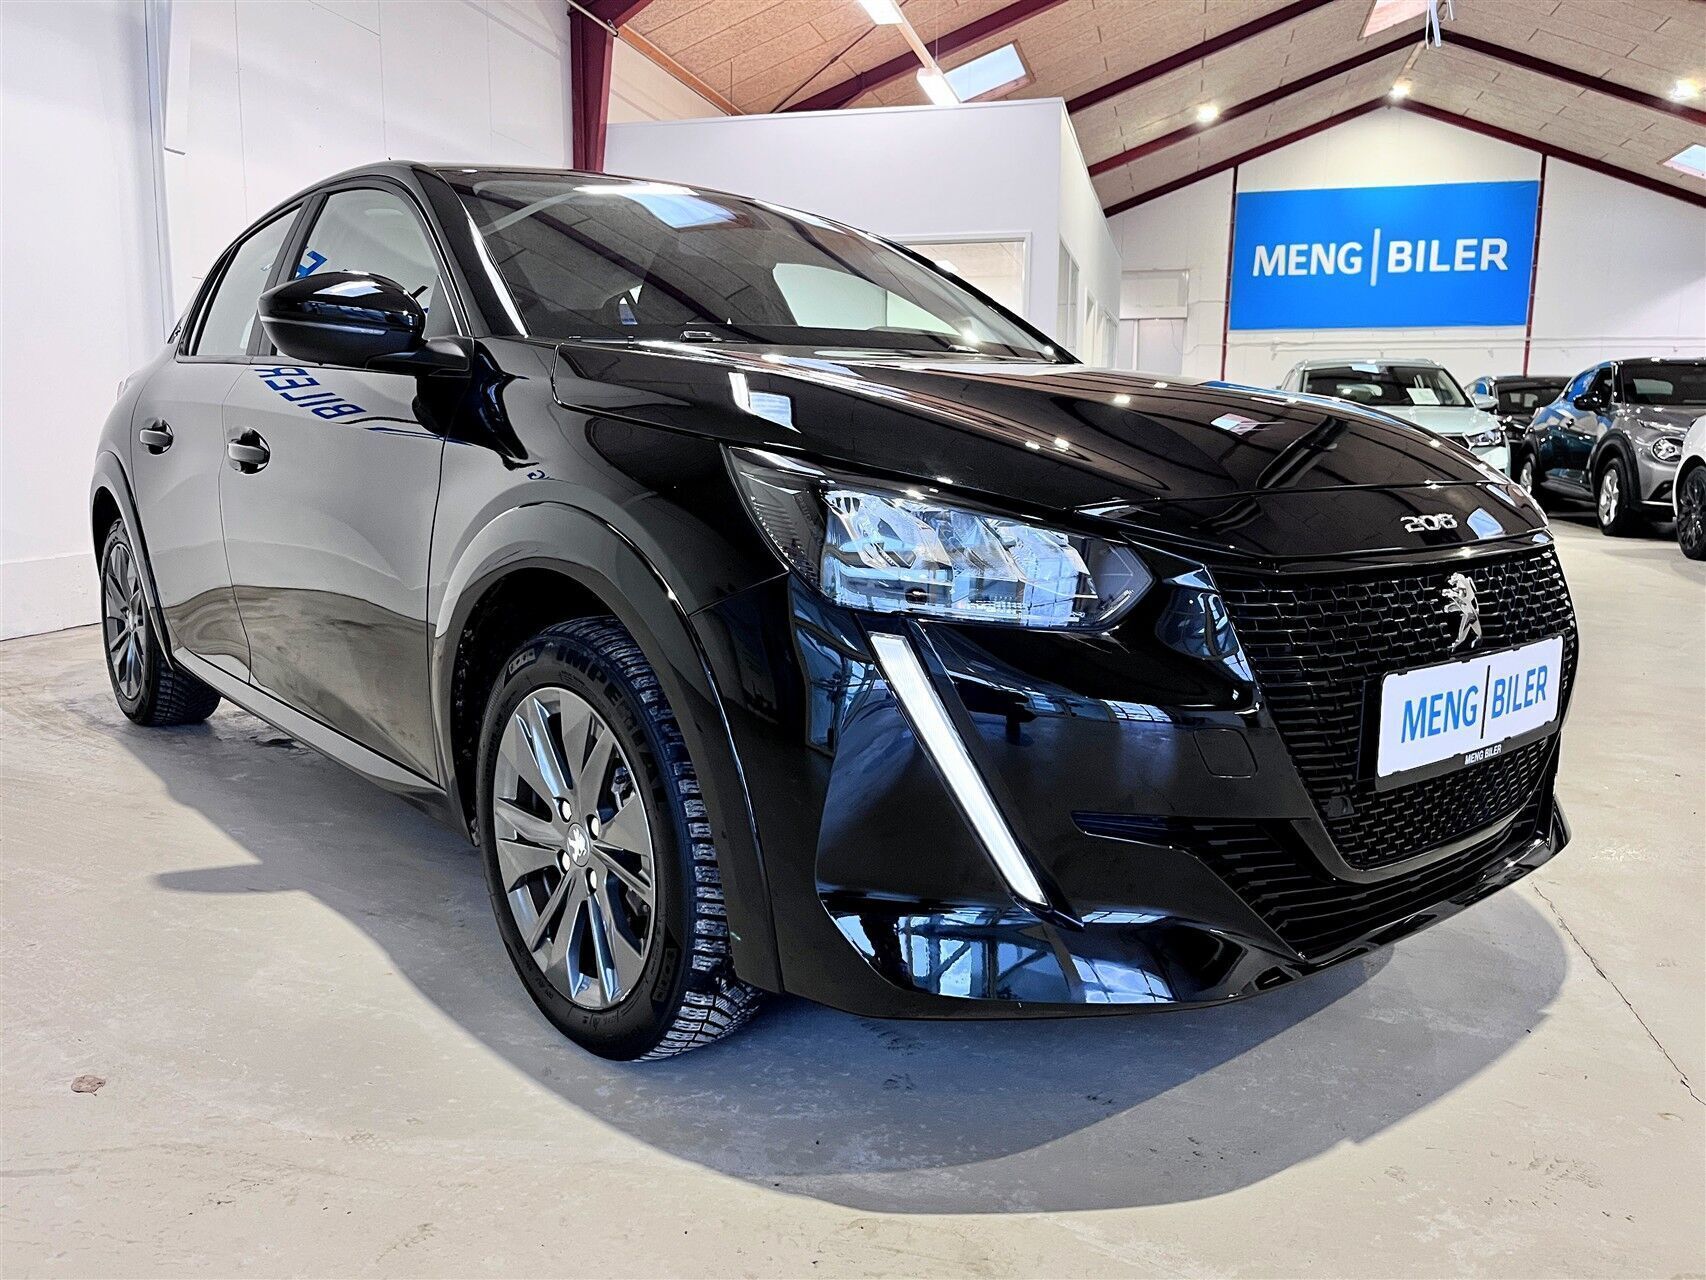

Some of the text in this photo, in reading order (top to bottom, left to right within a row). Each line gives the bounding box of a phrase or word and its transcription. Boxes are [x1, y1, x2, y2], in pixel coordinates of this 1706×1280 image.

[1252, 238, 1509, 277] MENG BILER
[1400, 513, 1458, 533] 208
[1401, 664, 1548, 743] MENG BILER
[1464, 744, 1502, 766] MENG BILER
